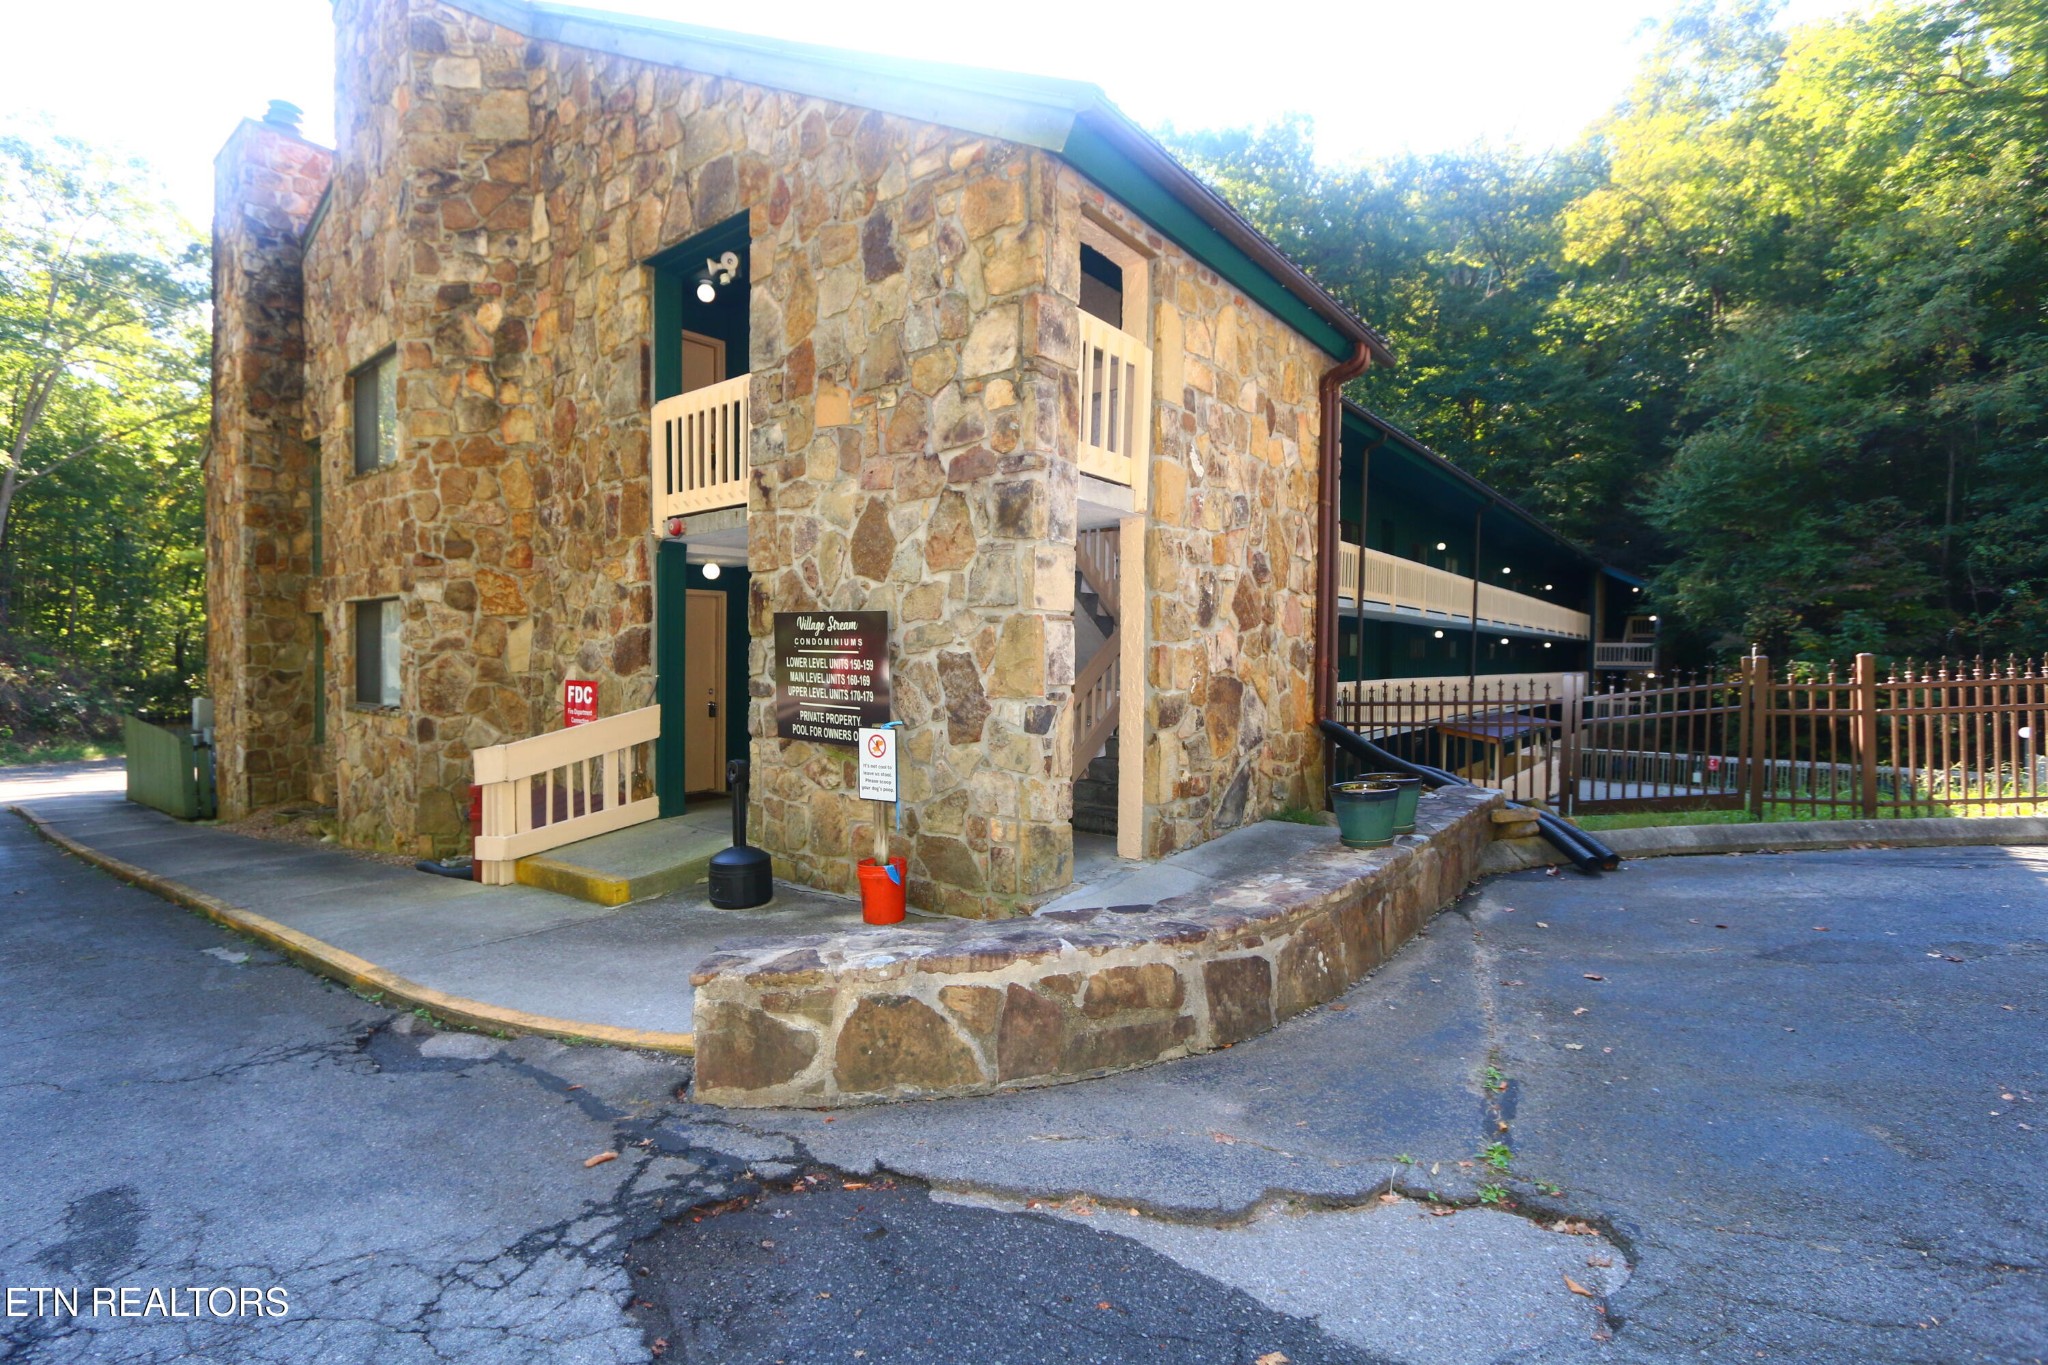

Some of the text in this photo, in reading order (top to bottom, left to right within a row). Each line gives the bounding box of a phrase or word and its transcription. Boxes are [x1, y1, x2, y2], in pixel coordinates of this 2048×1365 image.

[796, 615, 858, 636] Village Stream
[794, 638, 863, 646] CONDOMINIUMS
[786, 656, 874, 671] LOWER LEVEL UNITS 150-159
[790, 671, 871, 687] MAIN LEVEL UNITS 160-169
[568, 685, 593, 704] FDC
[787, 685, 874, 702] UPPER LEVEL UNITS 170-179
[800, 710, 861, 726] PRIVATE PROPERTY
[792, 723, 809, 735] POOL
[809, 725, 823, 738] FOR
[823, 727, 852, 741] OWNERS
